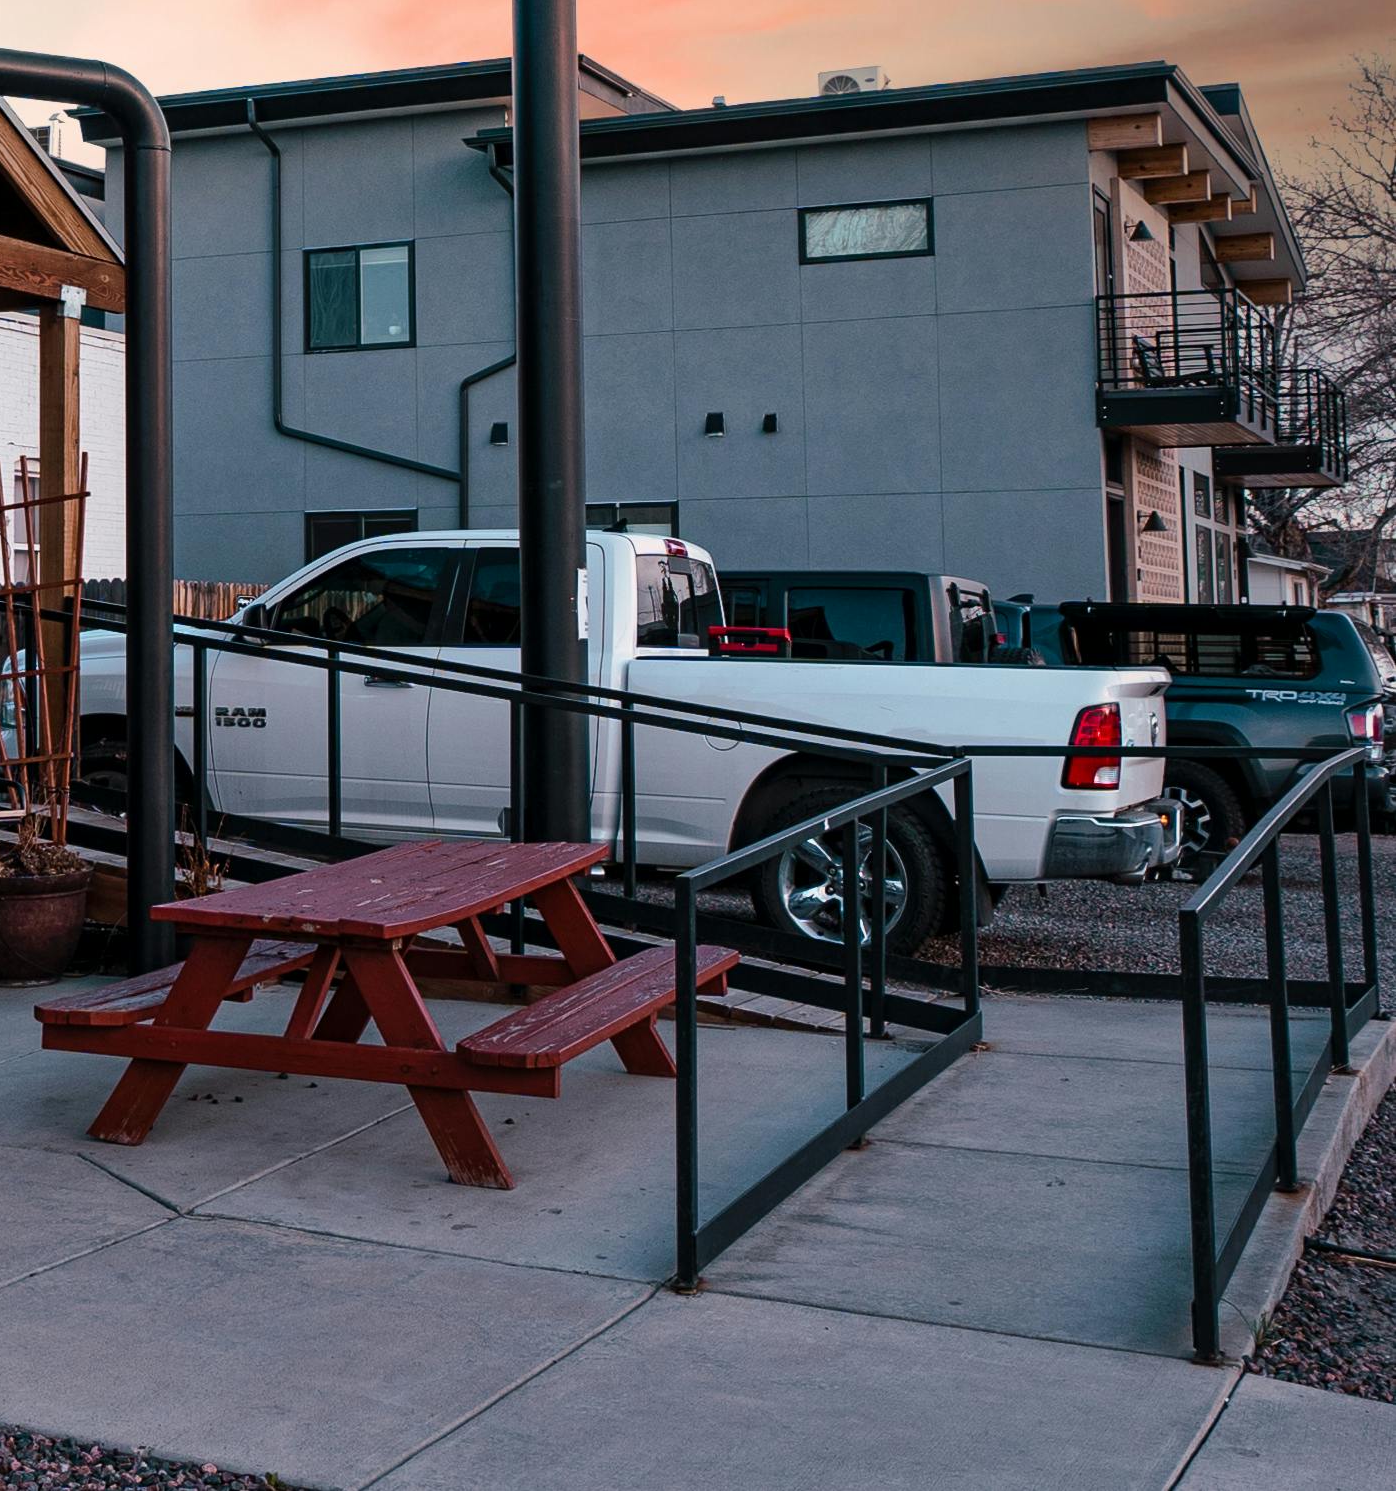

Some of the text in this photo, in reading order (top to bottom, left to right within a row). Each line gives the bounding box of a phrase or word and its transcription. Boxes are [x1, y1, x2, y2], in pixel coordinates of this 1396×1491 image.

[1245, 689, 1298, 702] TRD
[214, 706, 267, 718] RAM
[214, 716, 267, 728] 1500
